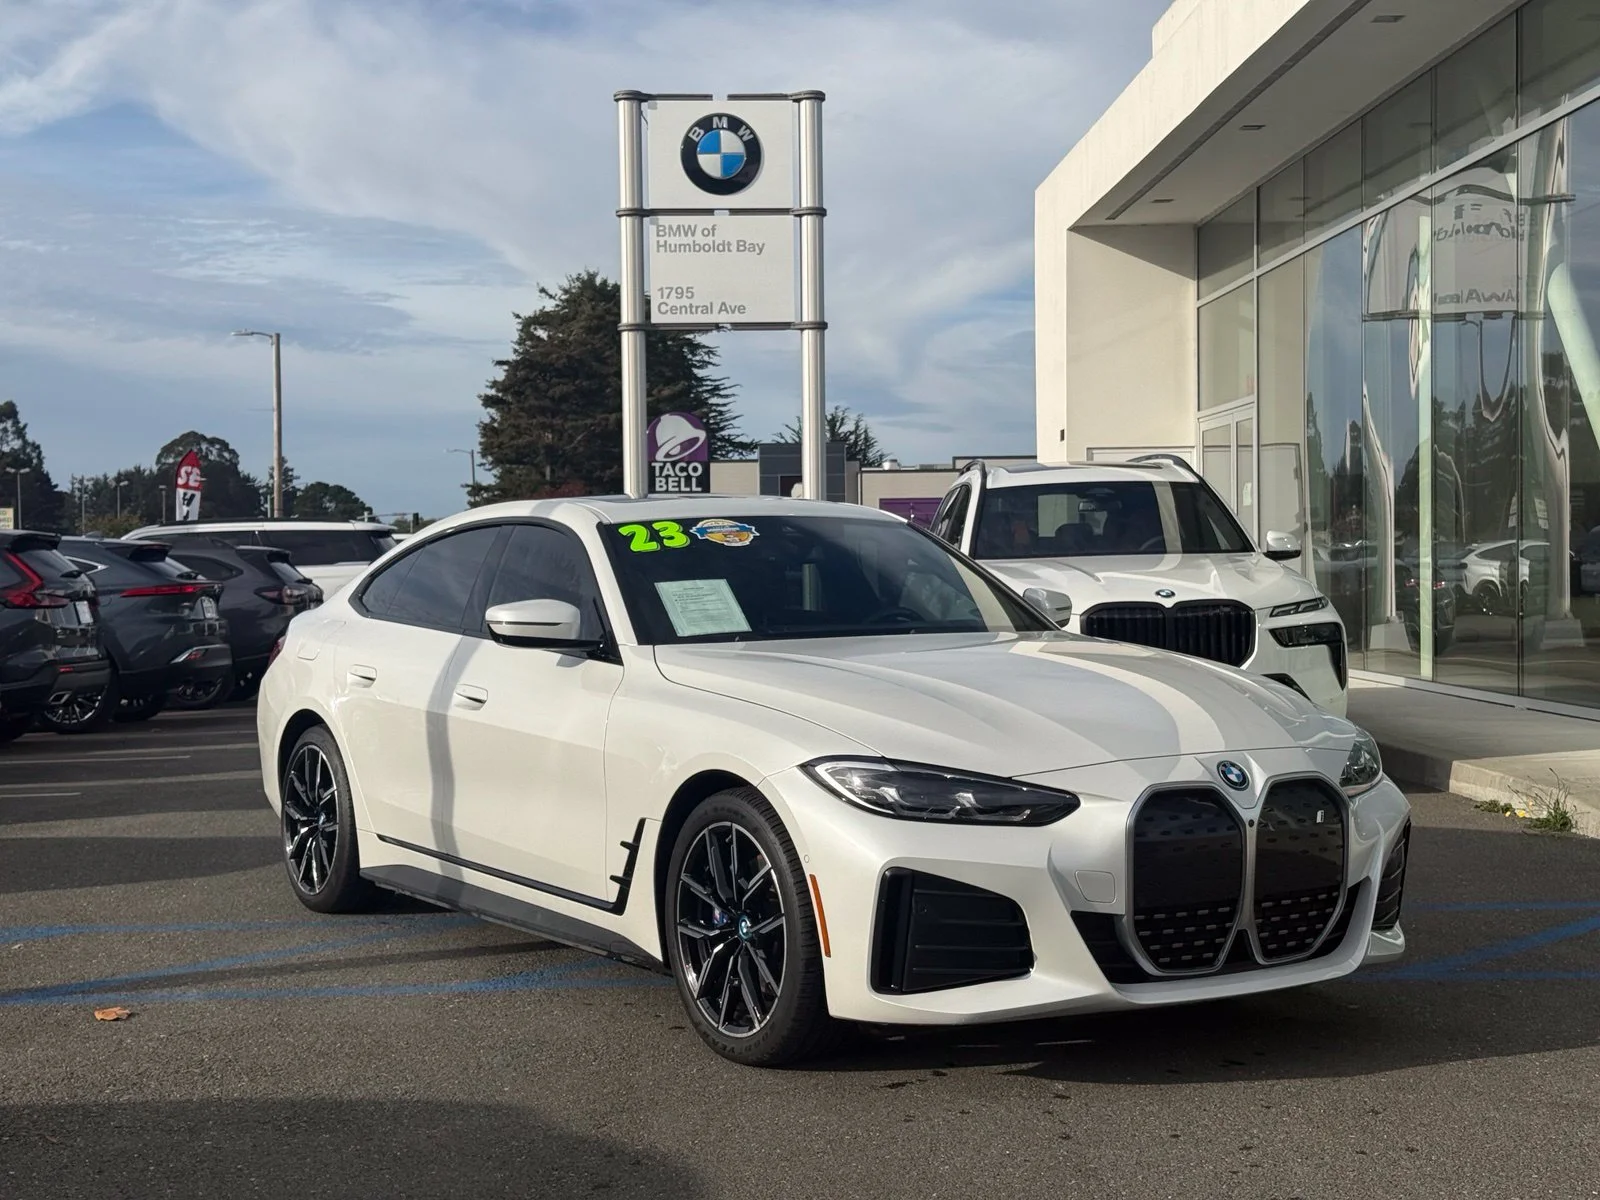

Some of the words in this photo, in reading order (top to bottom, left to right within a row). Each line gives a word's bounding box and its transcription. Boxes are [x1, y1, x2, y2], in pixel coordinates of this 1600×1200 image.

[688, 116, 754, 142] BMW
[656, 224, 697, 238] BMW
[701, 224, 717, 238] of
[656, 240, 731, 253] Humboldt
[736, 240, 765, 256] Bay
[657, 286, 694, 299] 1795
[657, 302, 713, 315] Central
[718, 302, 746, 315] Ave
[651, 462, 702, 477] TACO
[655, 477, 702, 492] BELL
[618, 520, 690, 552] 23
